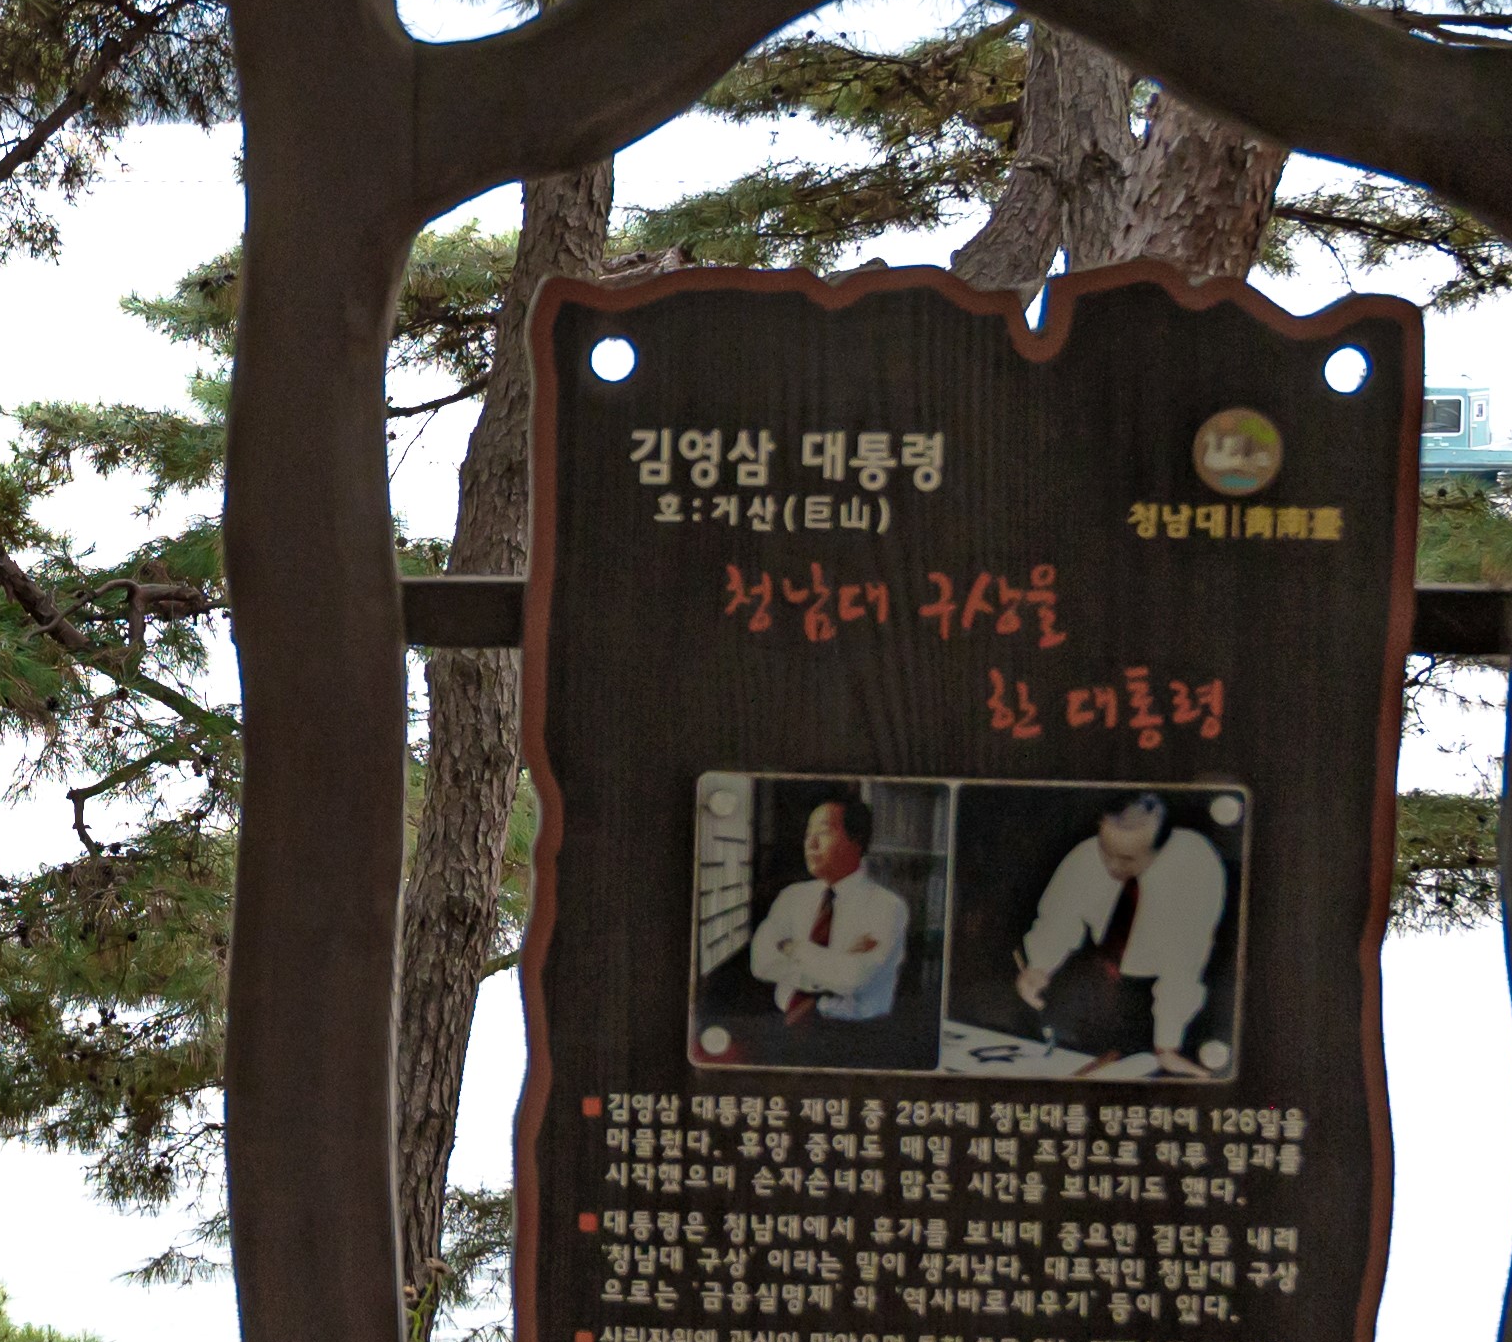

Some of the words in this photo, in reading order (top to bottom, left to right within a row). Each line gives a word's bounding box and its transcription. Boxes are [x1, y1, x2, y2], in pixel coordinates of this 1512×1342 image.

[629, 427, 779, 489] 김영삼
[801, 430, 946, 493] 대통령
[723, 562, 891, 641] 청남대
[919, 564, 1067, 648] 구상을
[987, 668, 1044, 740] 한
[1066, 665, 1224, 749] 대통령
[608, 1092, 679, 1124] 김영삼
[691, 1095, 789, 1127] 대통령은
[800, 1097, 848, 1129] 재임
[861, 1099, 885, 1131] 중
[895, 1100, 978, 1128] 28차례
[990, 1102, 1087, 1134] 청남대를
[1100, 1105, 1197, 1137] 방문하여
[1210, 1106, 1305, 1141] 126일을
[737, 1131, 790, 1162] 휴양
[804, 1132, 883, 1163] 중에도
[899, 1135, 950, 1166] 매일
[967, 1137, 1018, 1166] 새벽
[1034, 1138, 1138, 1170] 조깅으로
[1156, 1141, 1206, 1167] 하루
[1223, 1142, 1302, 1175] 일과를
[605, 1162, 735, 1193] 시작했으며
[751, 1165, 883, 1197] 손자손녀와
[900, 1168, 950, 1201] 많은
[968, 1171, 1045, 1203] 시간을
[1061, 1174, 1166, 1201] 보내기도
[1182, 1176, 1244, 1206] 했다.
[603, 1209, 706, 1243] 대통령은
[723, 1212, 853, 1244] 청남대에서
[871, 1216, 947, 1248] 휴가를
[963, 1220, 1041, 1246] 보내며
[1058, 1221, 1136, 1254] 중요한
[1153, 1224, 1229, 1256] 결단을
[1247, 1226, 1298, 1253] 내려
[767, 1248, 841, 1280] 이라는
[856, 1250, 904, 1281] 말이
[919, 1253, 1029, 1283] 생겨났다.
[1044, 1256, 1144, 1289] 대표적인
[1158, 1258, 1235, 1290] 청남대
[1247, 1261, 1299, 1293] 구상
[601, 1277, 678, 1310] 으로는
[853, 1285, 877, 1310] 와
[1108, 1291, 1159, 1323] 등이
[1176, 1294, 1238, 1323] 있다.
